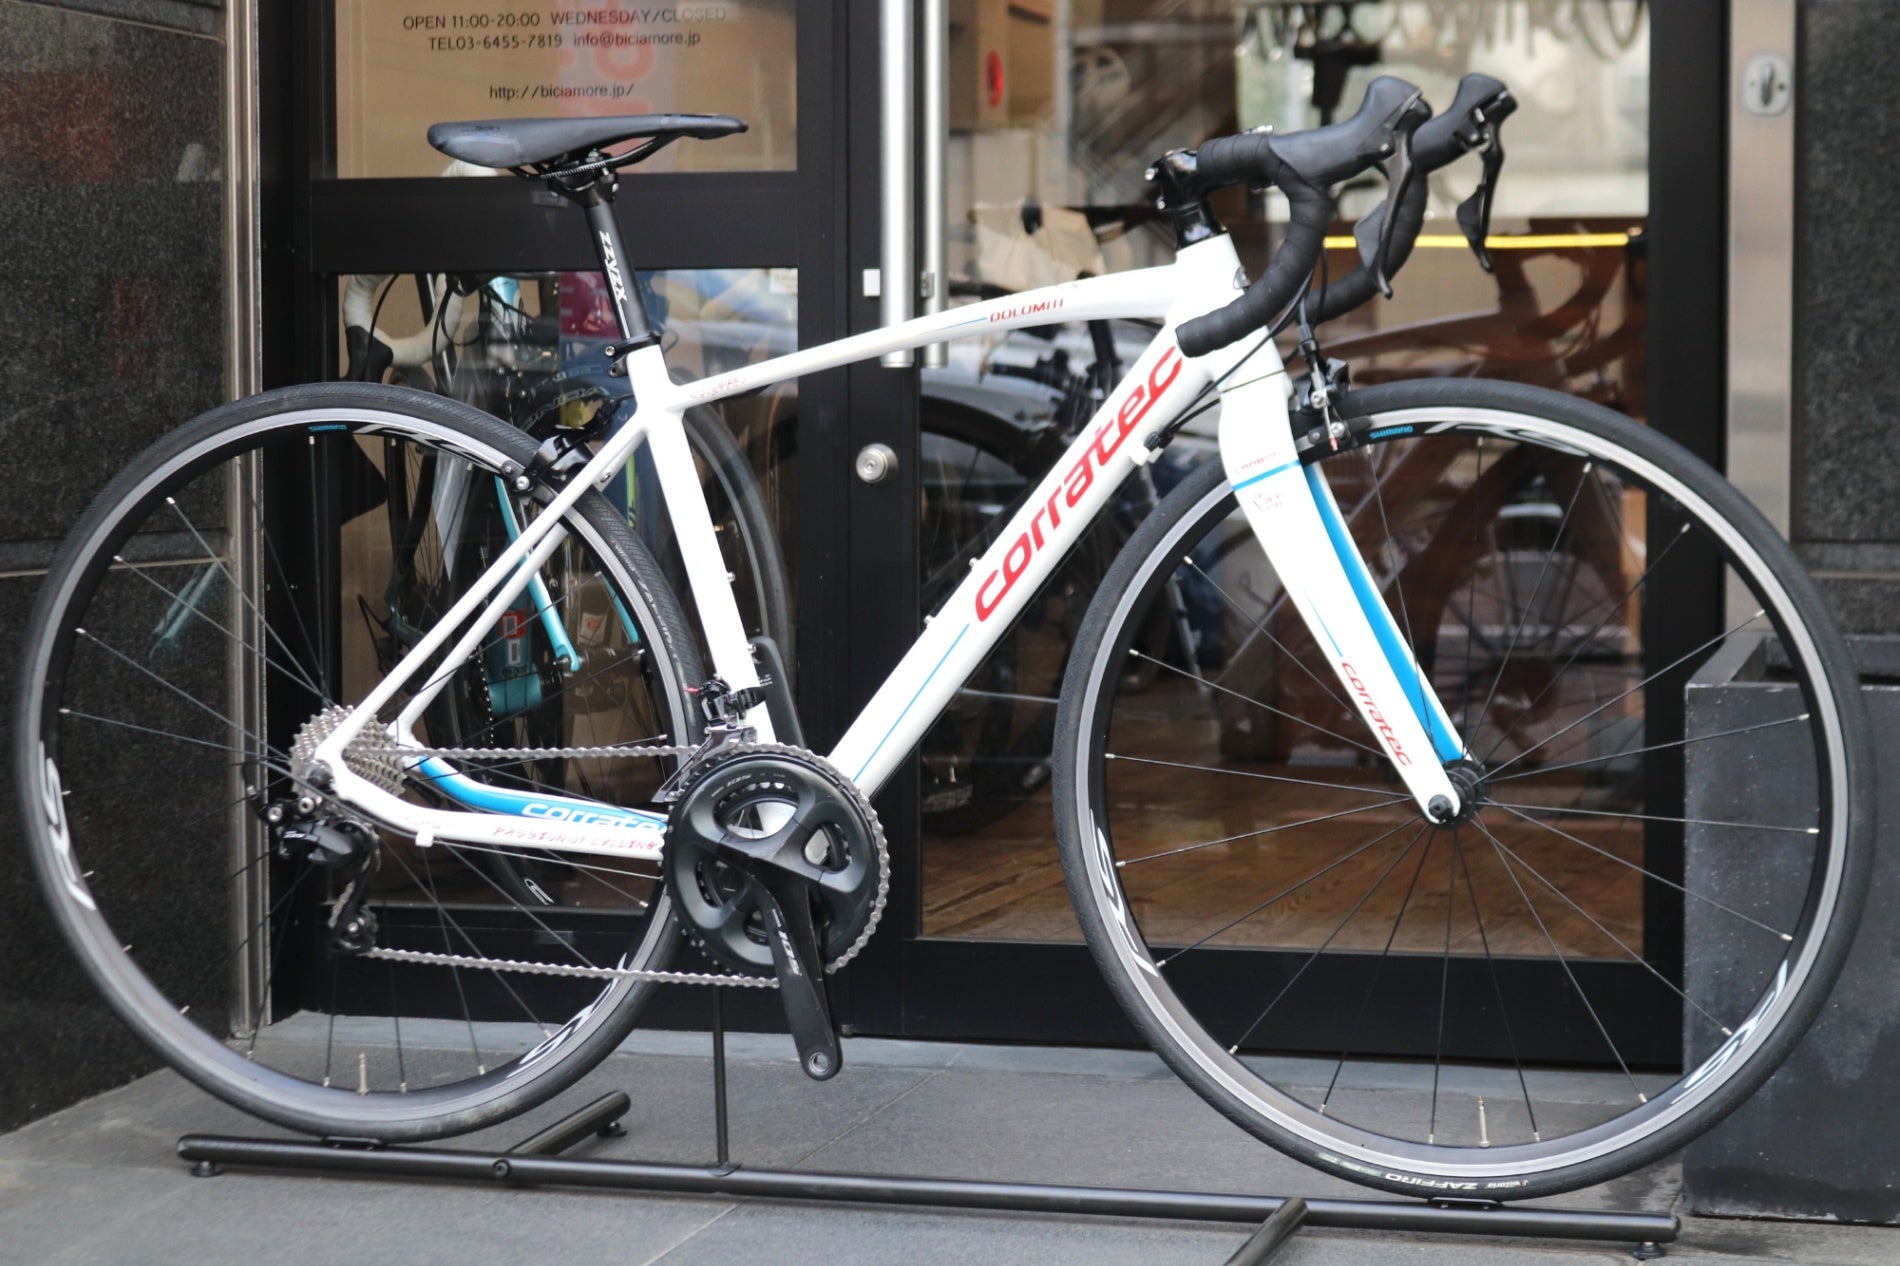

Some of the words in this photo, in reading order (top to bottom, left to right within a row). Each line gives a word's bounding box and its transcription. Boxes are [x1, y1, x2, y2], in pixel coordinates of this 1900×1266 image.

[403, 15, 446, 30] OPEN
[452, 12, 540, 28] 11:00-20:00
[551, 7, 727, 25] WEDNESDAY/CLOSED
[428, 34, 563, 51] TEL03-6455-7819
[573, 29, 701, 47] info@biciamore.jp
[489, 83, 635, 101] http://biciamore.jp/
[975, 345, 1183, 622] corratec
[1341, 662, 1412, 767] corratec
[1385, 1173, 1479, 1190] ZAFFIRO
